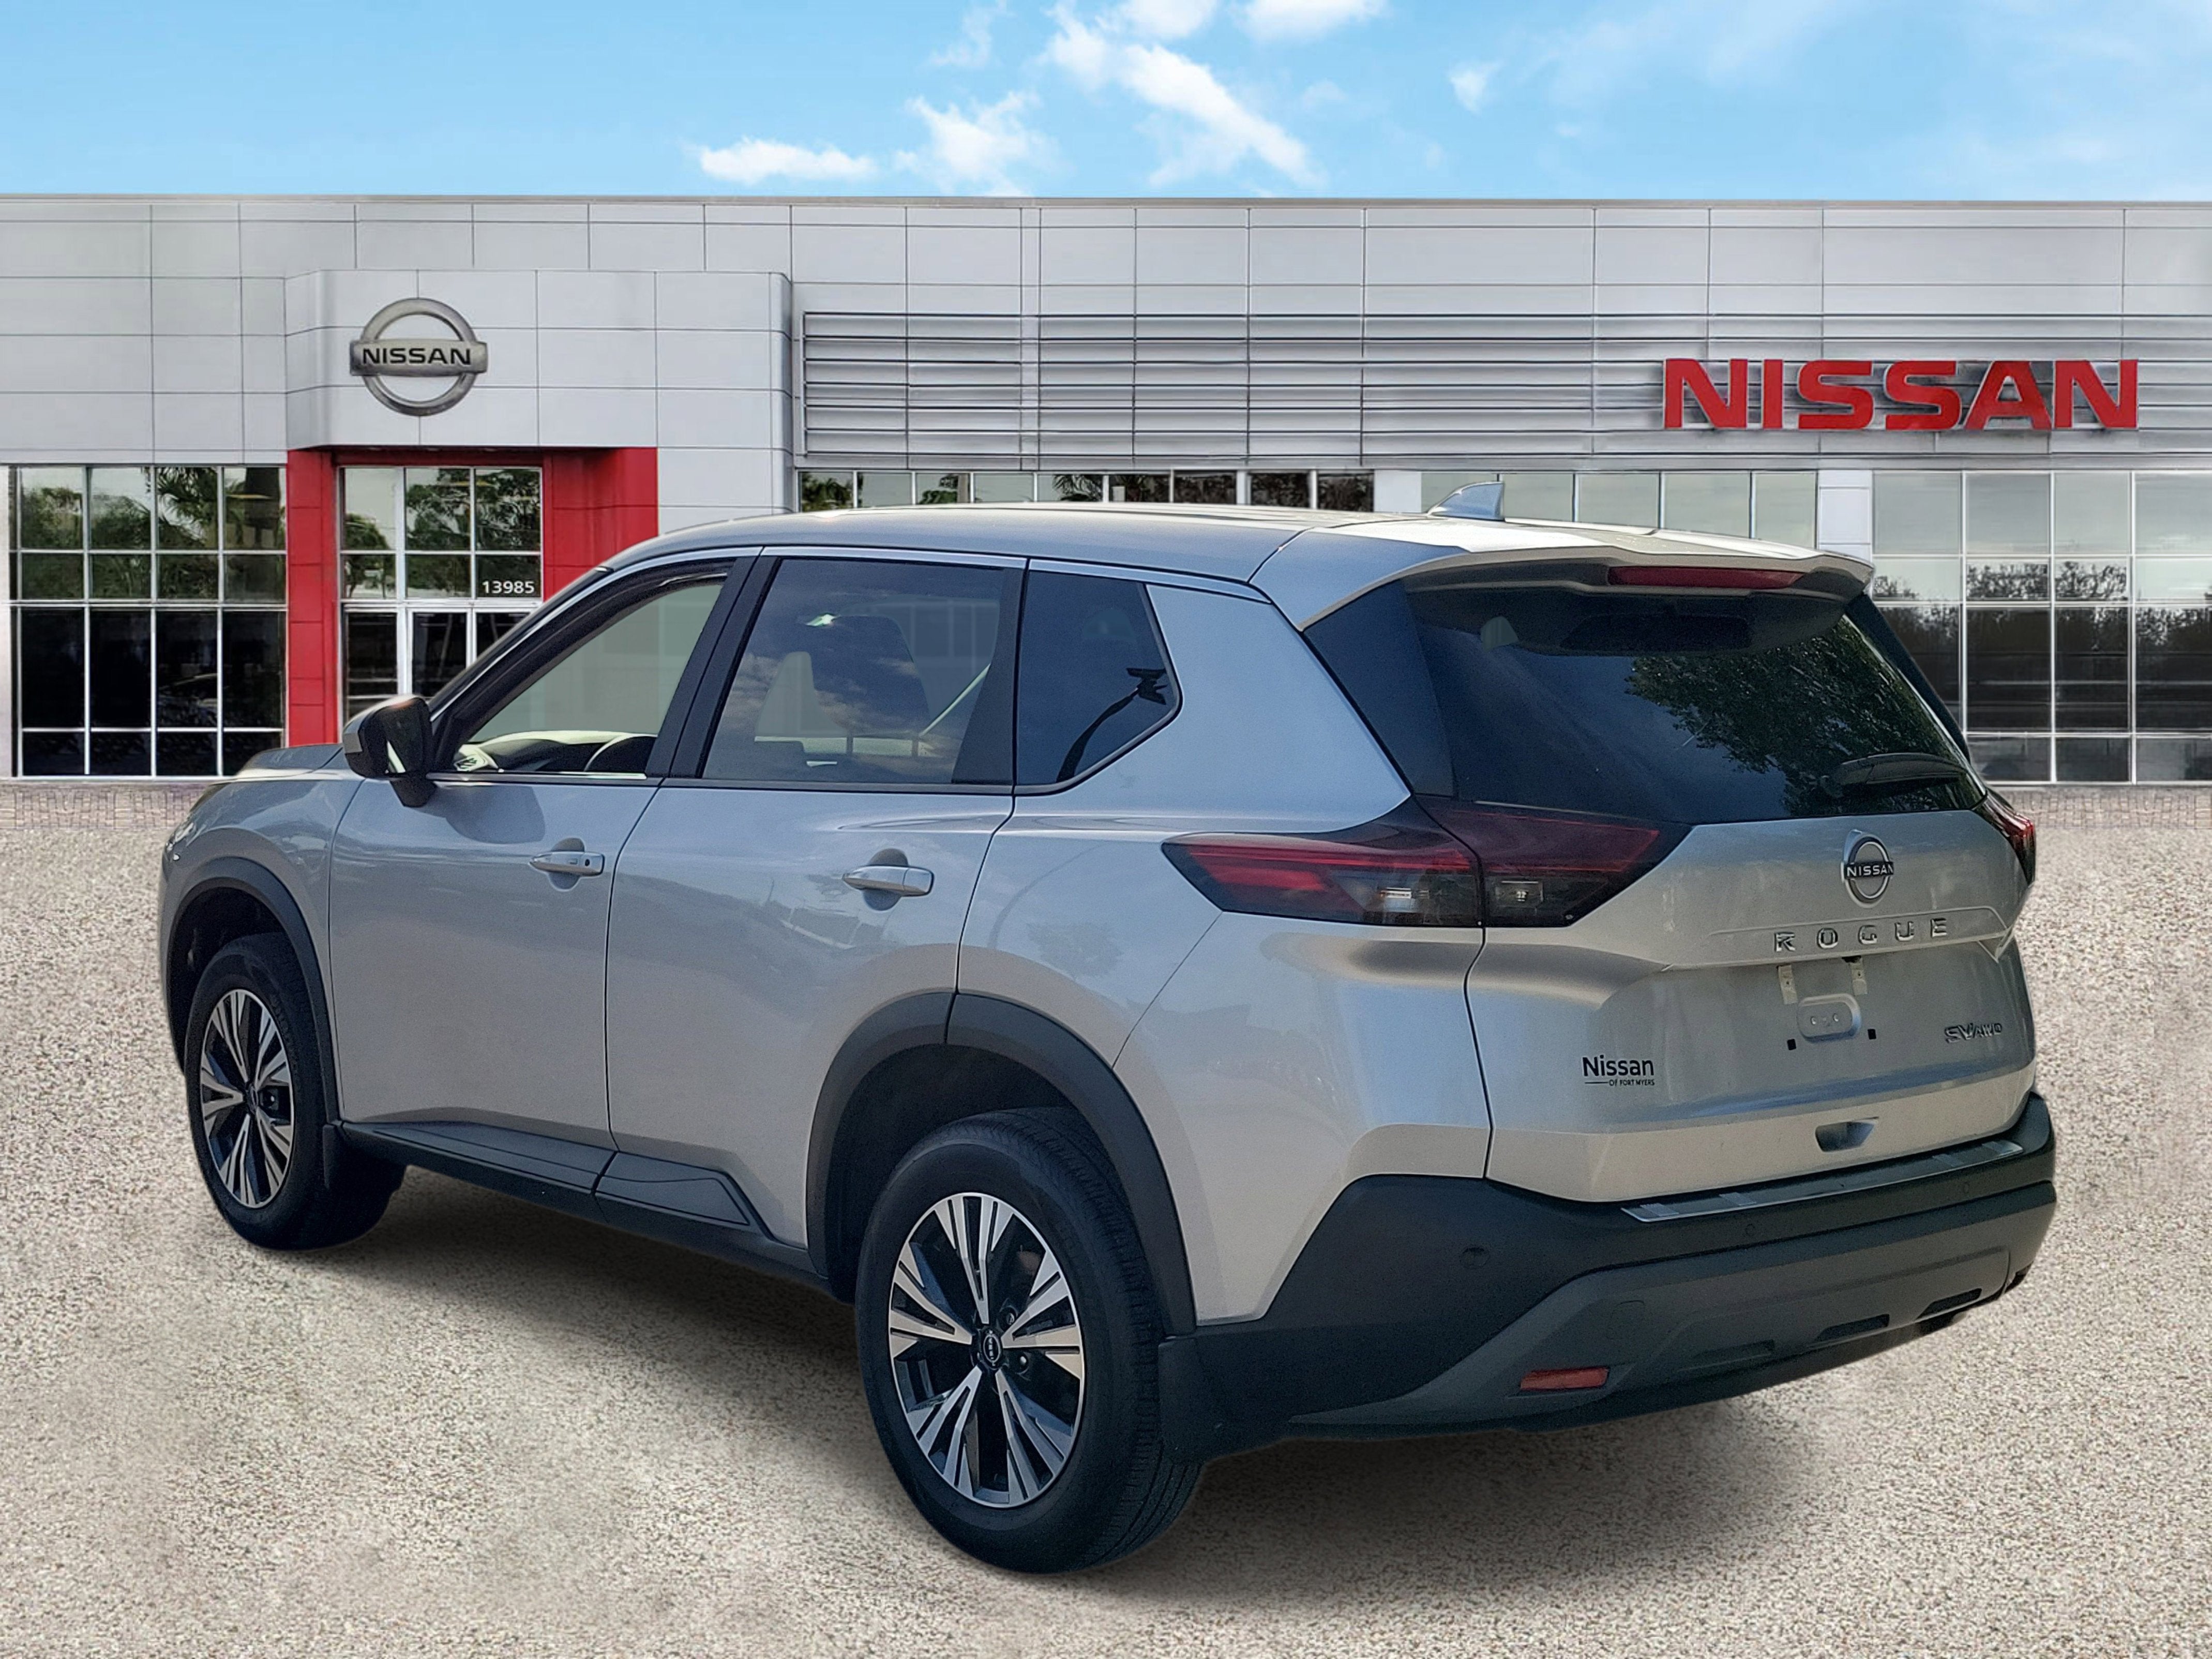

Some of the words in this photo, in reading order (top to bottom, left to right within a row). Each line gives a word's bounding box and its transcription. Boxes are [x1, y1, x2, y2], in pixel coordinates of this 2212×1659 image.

[363, 348, 471, 365] NISSAN
[1663, 358, 2139, 429] NISSAN
[482, 580, 535, 594] 13985
[1847, 864, 1893, 877] NISSAN
[1774, 918, 1948, 952] ROGUE
[1583, 1054, 1654, 1077] Nissan
